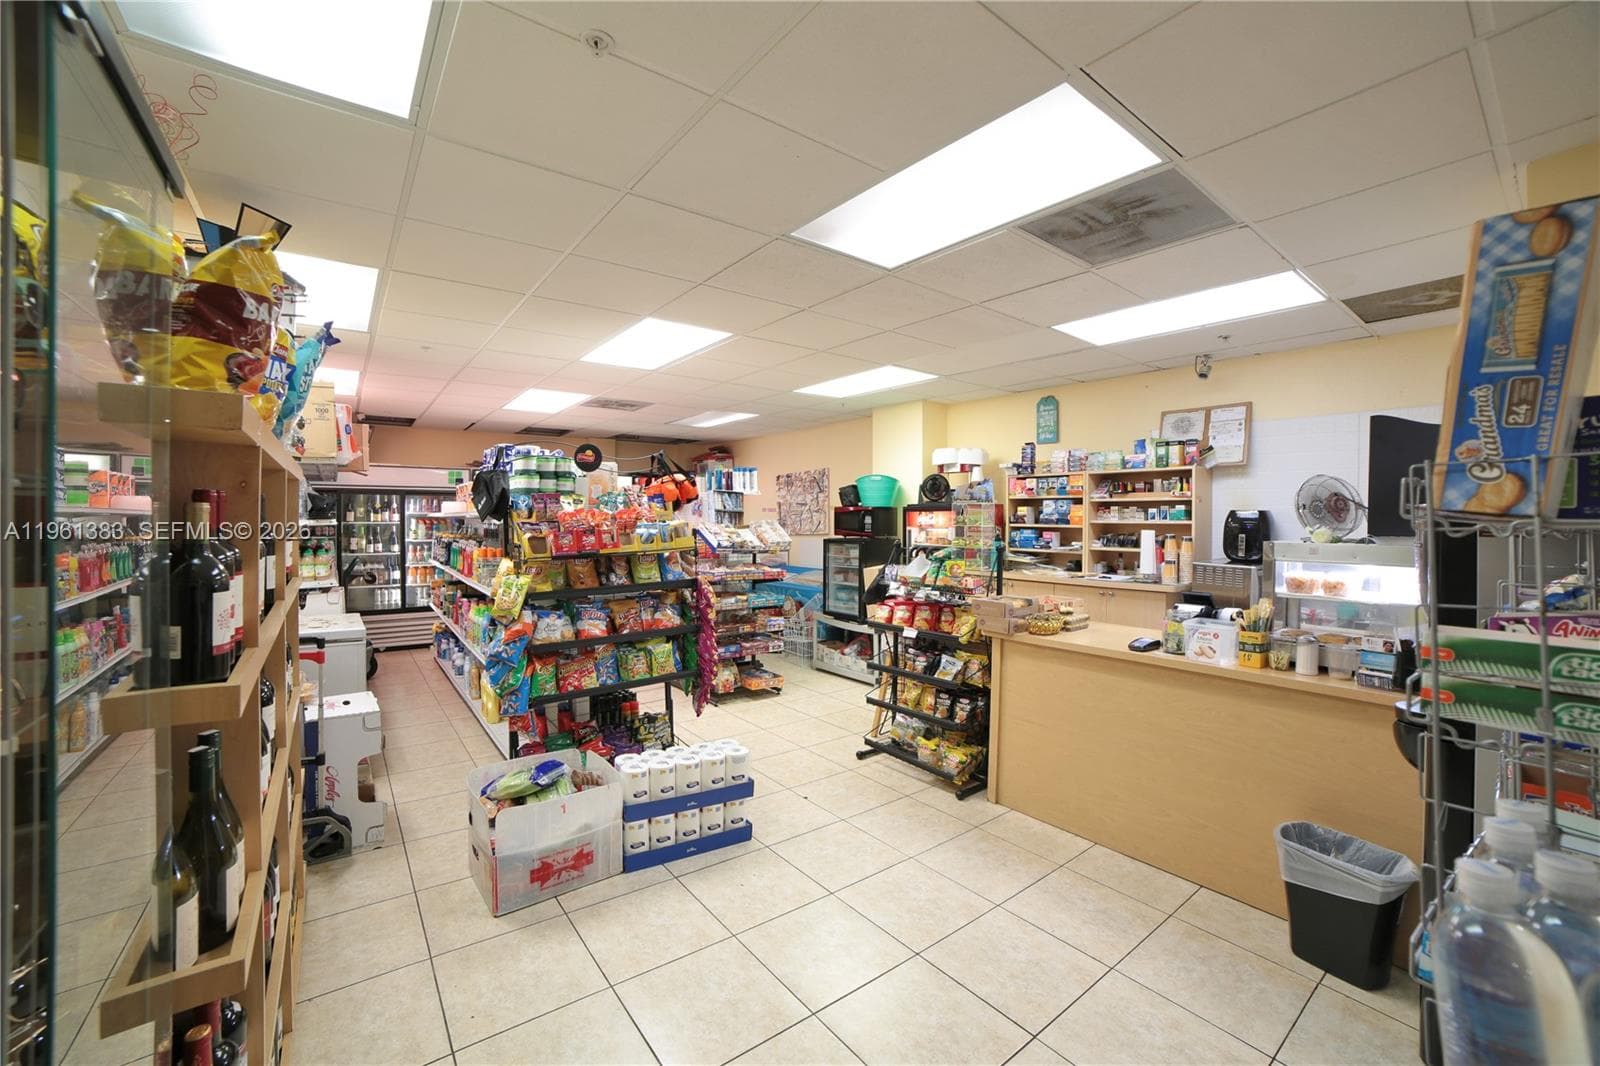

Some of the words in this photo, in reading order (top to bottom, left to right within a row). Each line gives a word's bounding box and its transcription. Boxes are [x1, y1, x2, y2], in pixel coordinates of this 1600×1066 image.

[1549, 343, 1567, 387] RESALE
[1507, 402, 1530, 424] 24
[1542, 389, 1558, 410] FOR
[1468, 384, 1504, 484] Grandma's
[1537, 416, 1552, 451] GREAT
